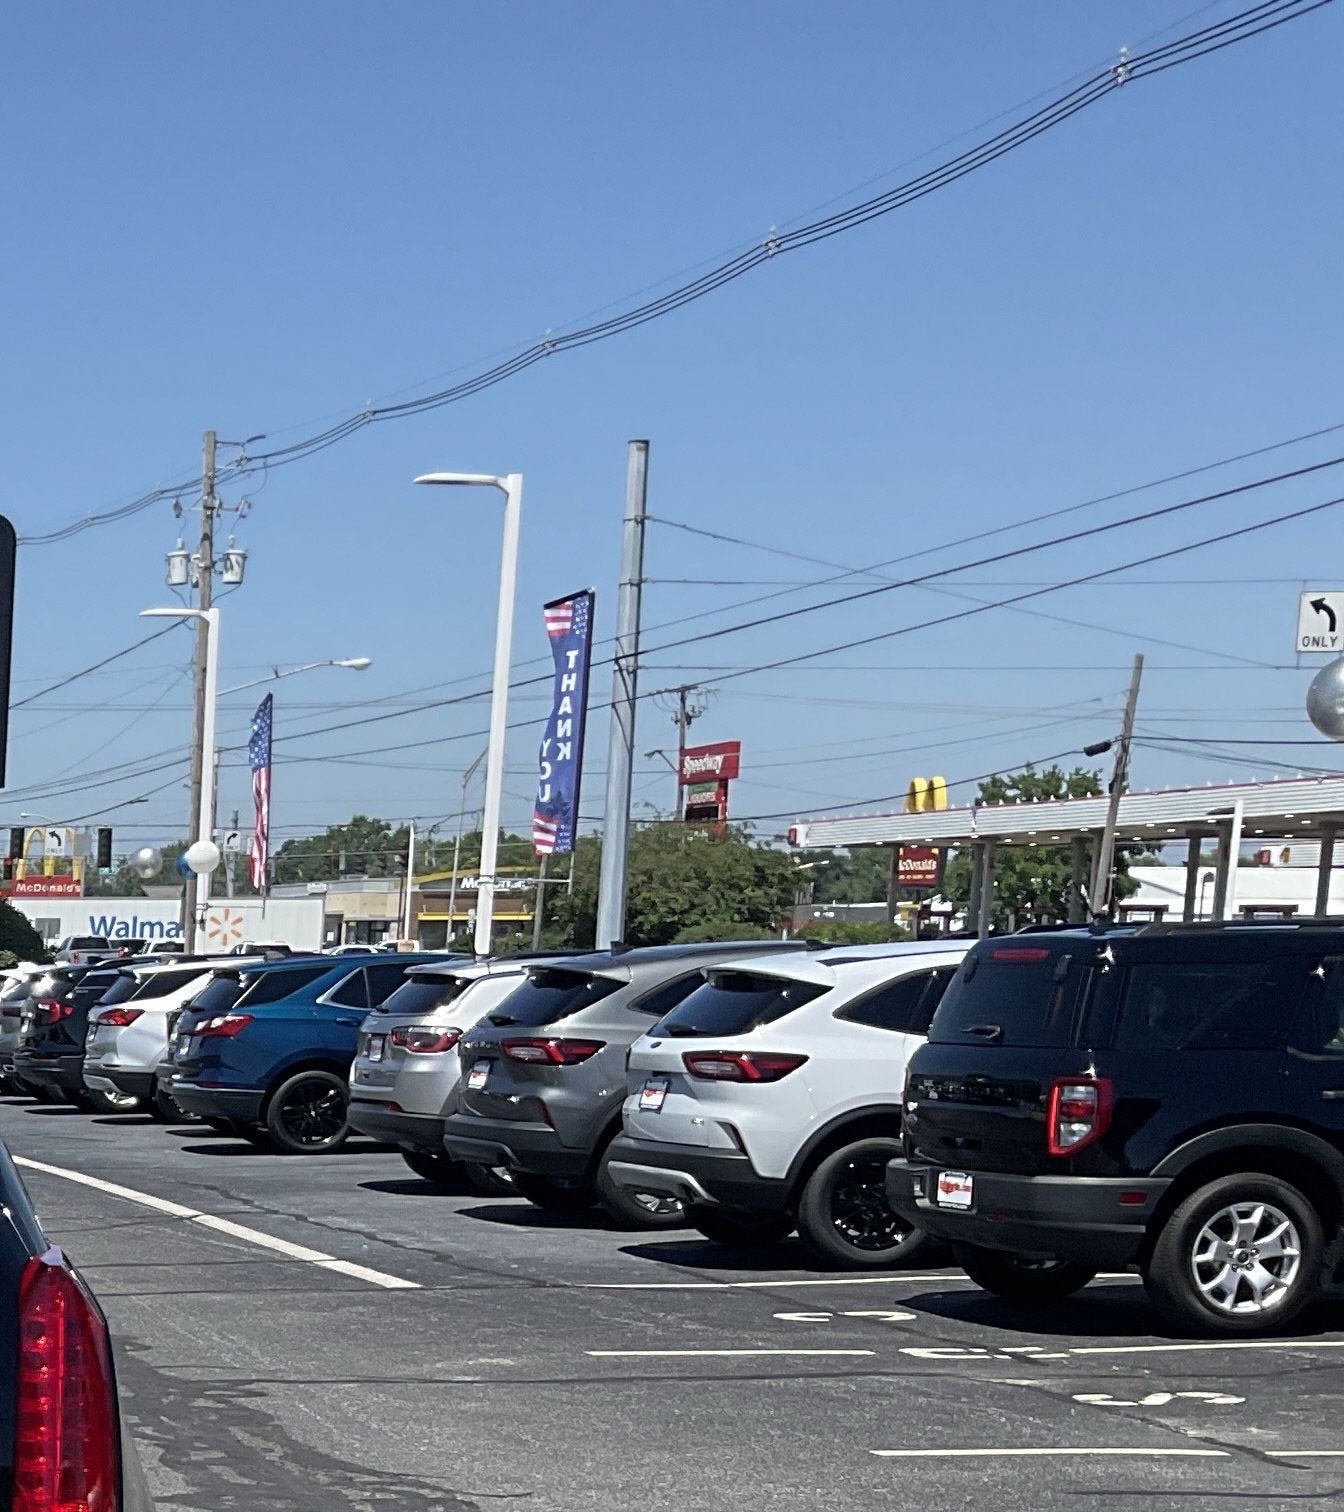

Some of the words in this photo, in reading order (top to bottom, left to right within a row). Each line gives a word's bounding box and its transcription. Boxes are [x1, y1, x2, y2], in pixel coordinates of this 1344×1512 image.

[1302, 635, 1338, 648] ONLY
[683, 754, 725, 778] Speedway
[15, 883, 81, 893] McDonald's
[89, 915, 184, 939] Walma
